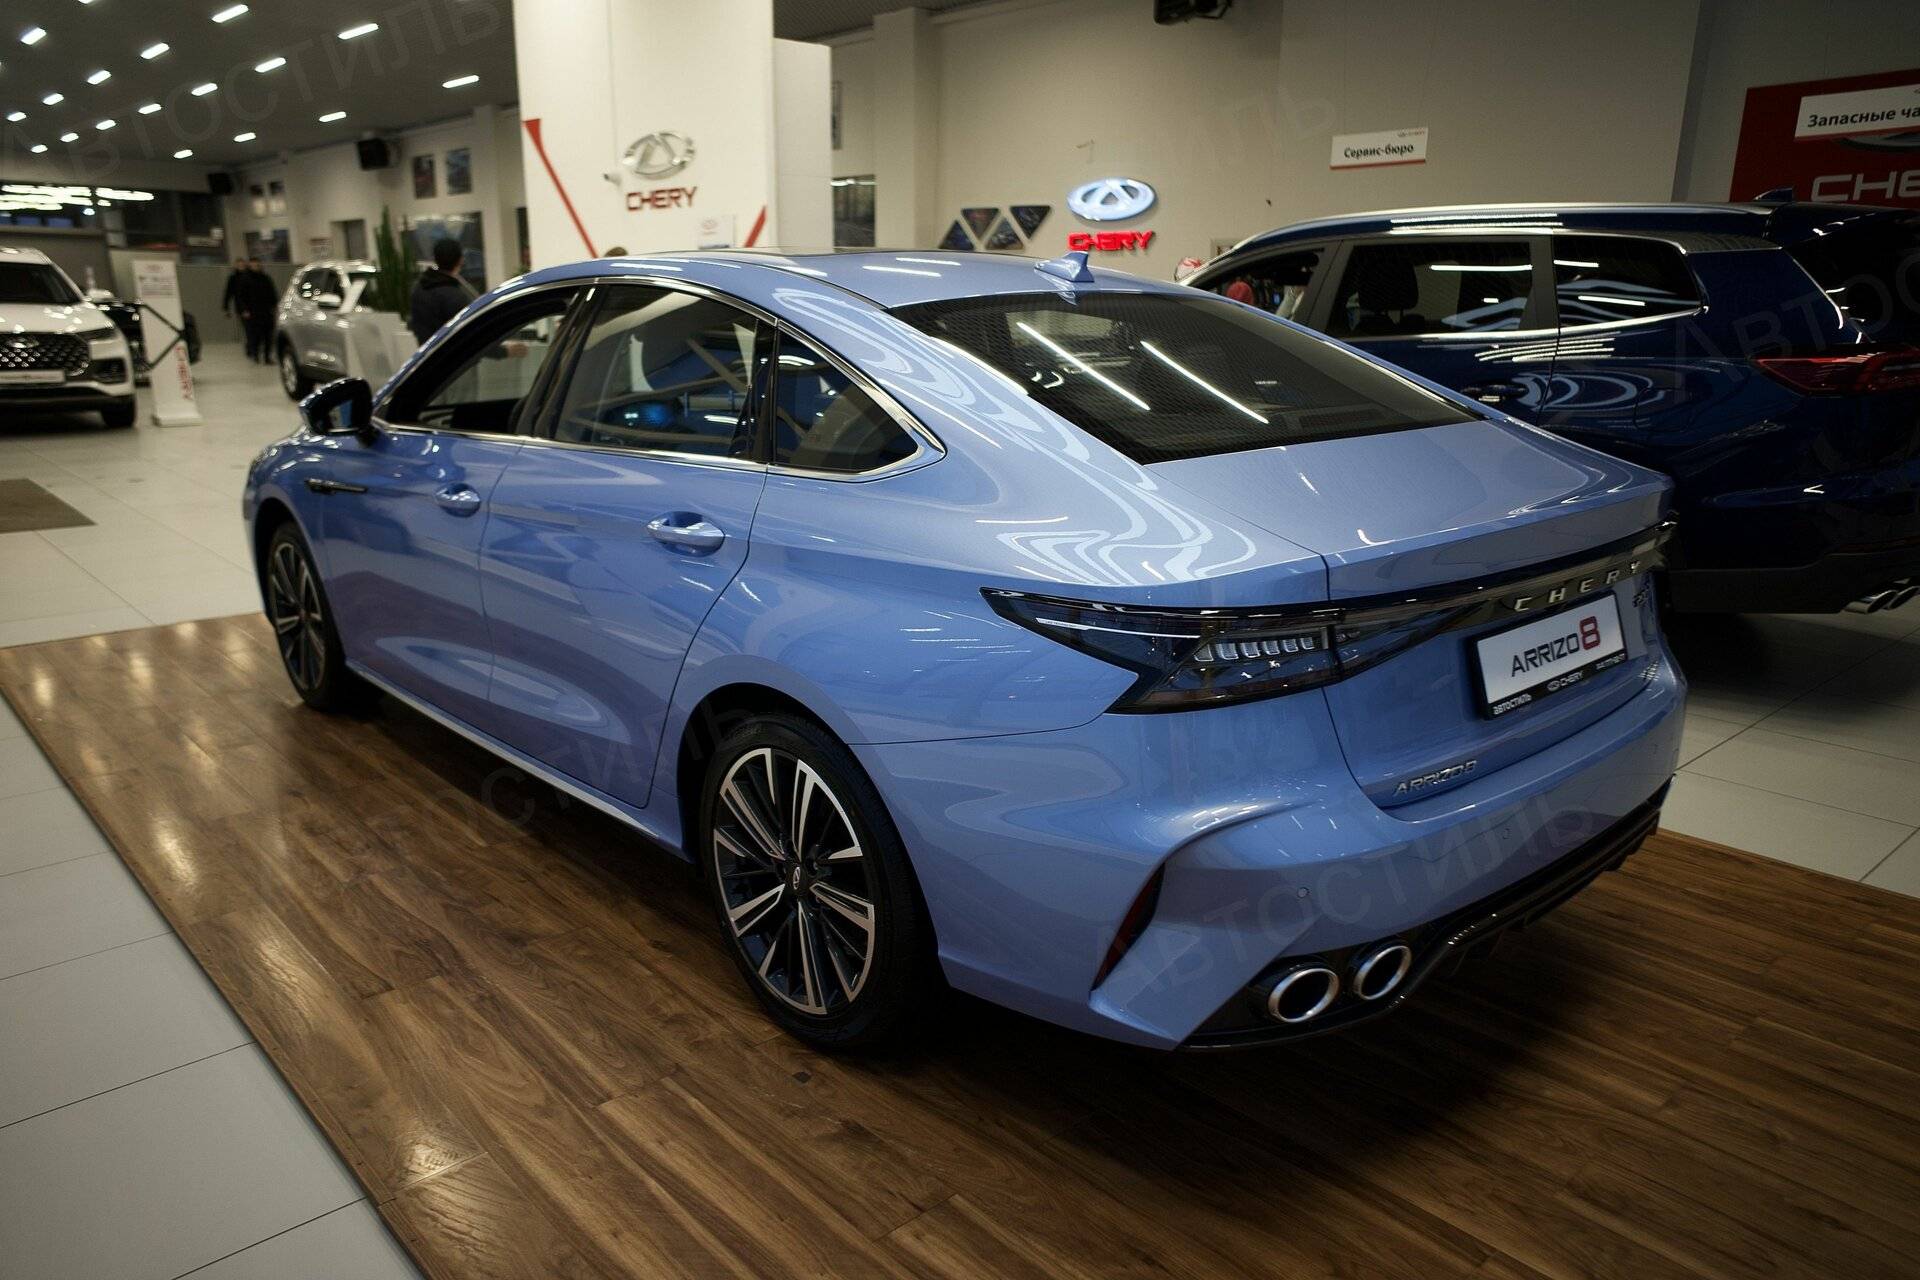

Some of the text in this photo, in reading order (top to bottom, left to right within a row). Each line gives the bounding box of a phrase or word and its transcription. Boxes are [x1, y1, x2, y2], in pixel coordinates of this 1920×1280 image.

[1807, 110, 1896, 128] Запасные
[1343, 143, 1415, 159] Сервис-бюро
[626, 186, 697, 211] CHERY
[1068, 230, 1153, 252] CHERY
[1513, 560, 1641, 612] CHERY
